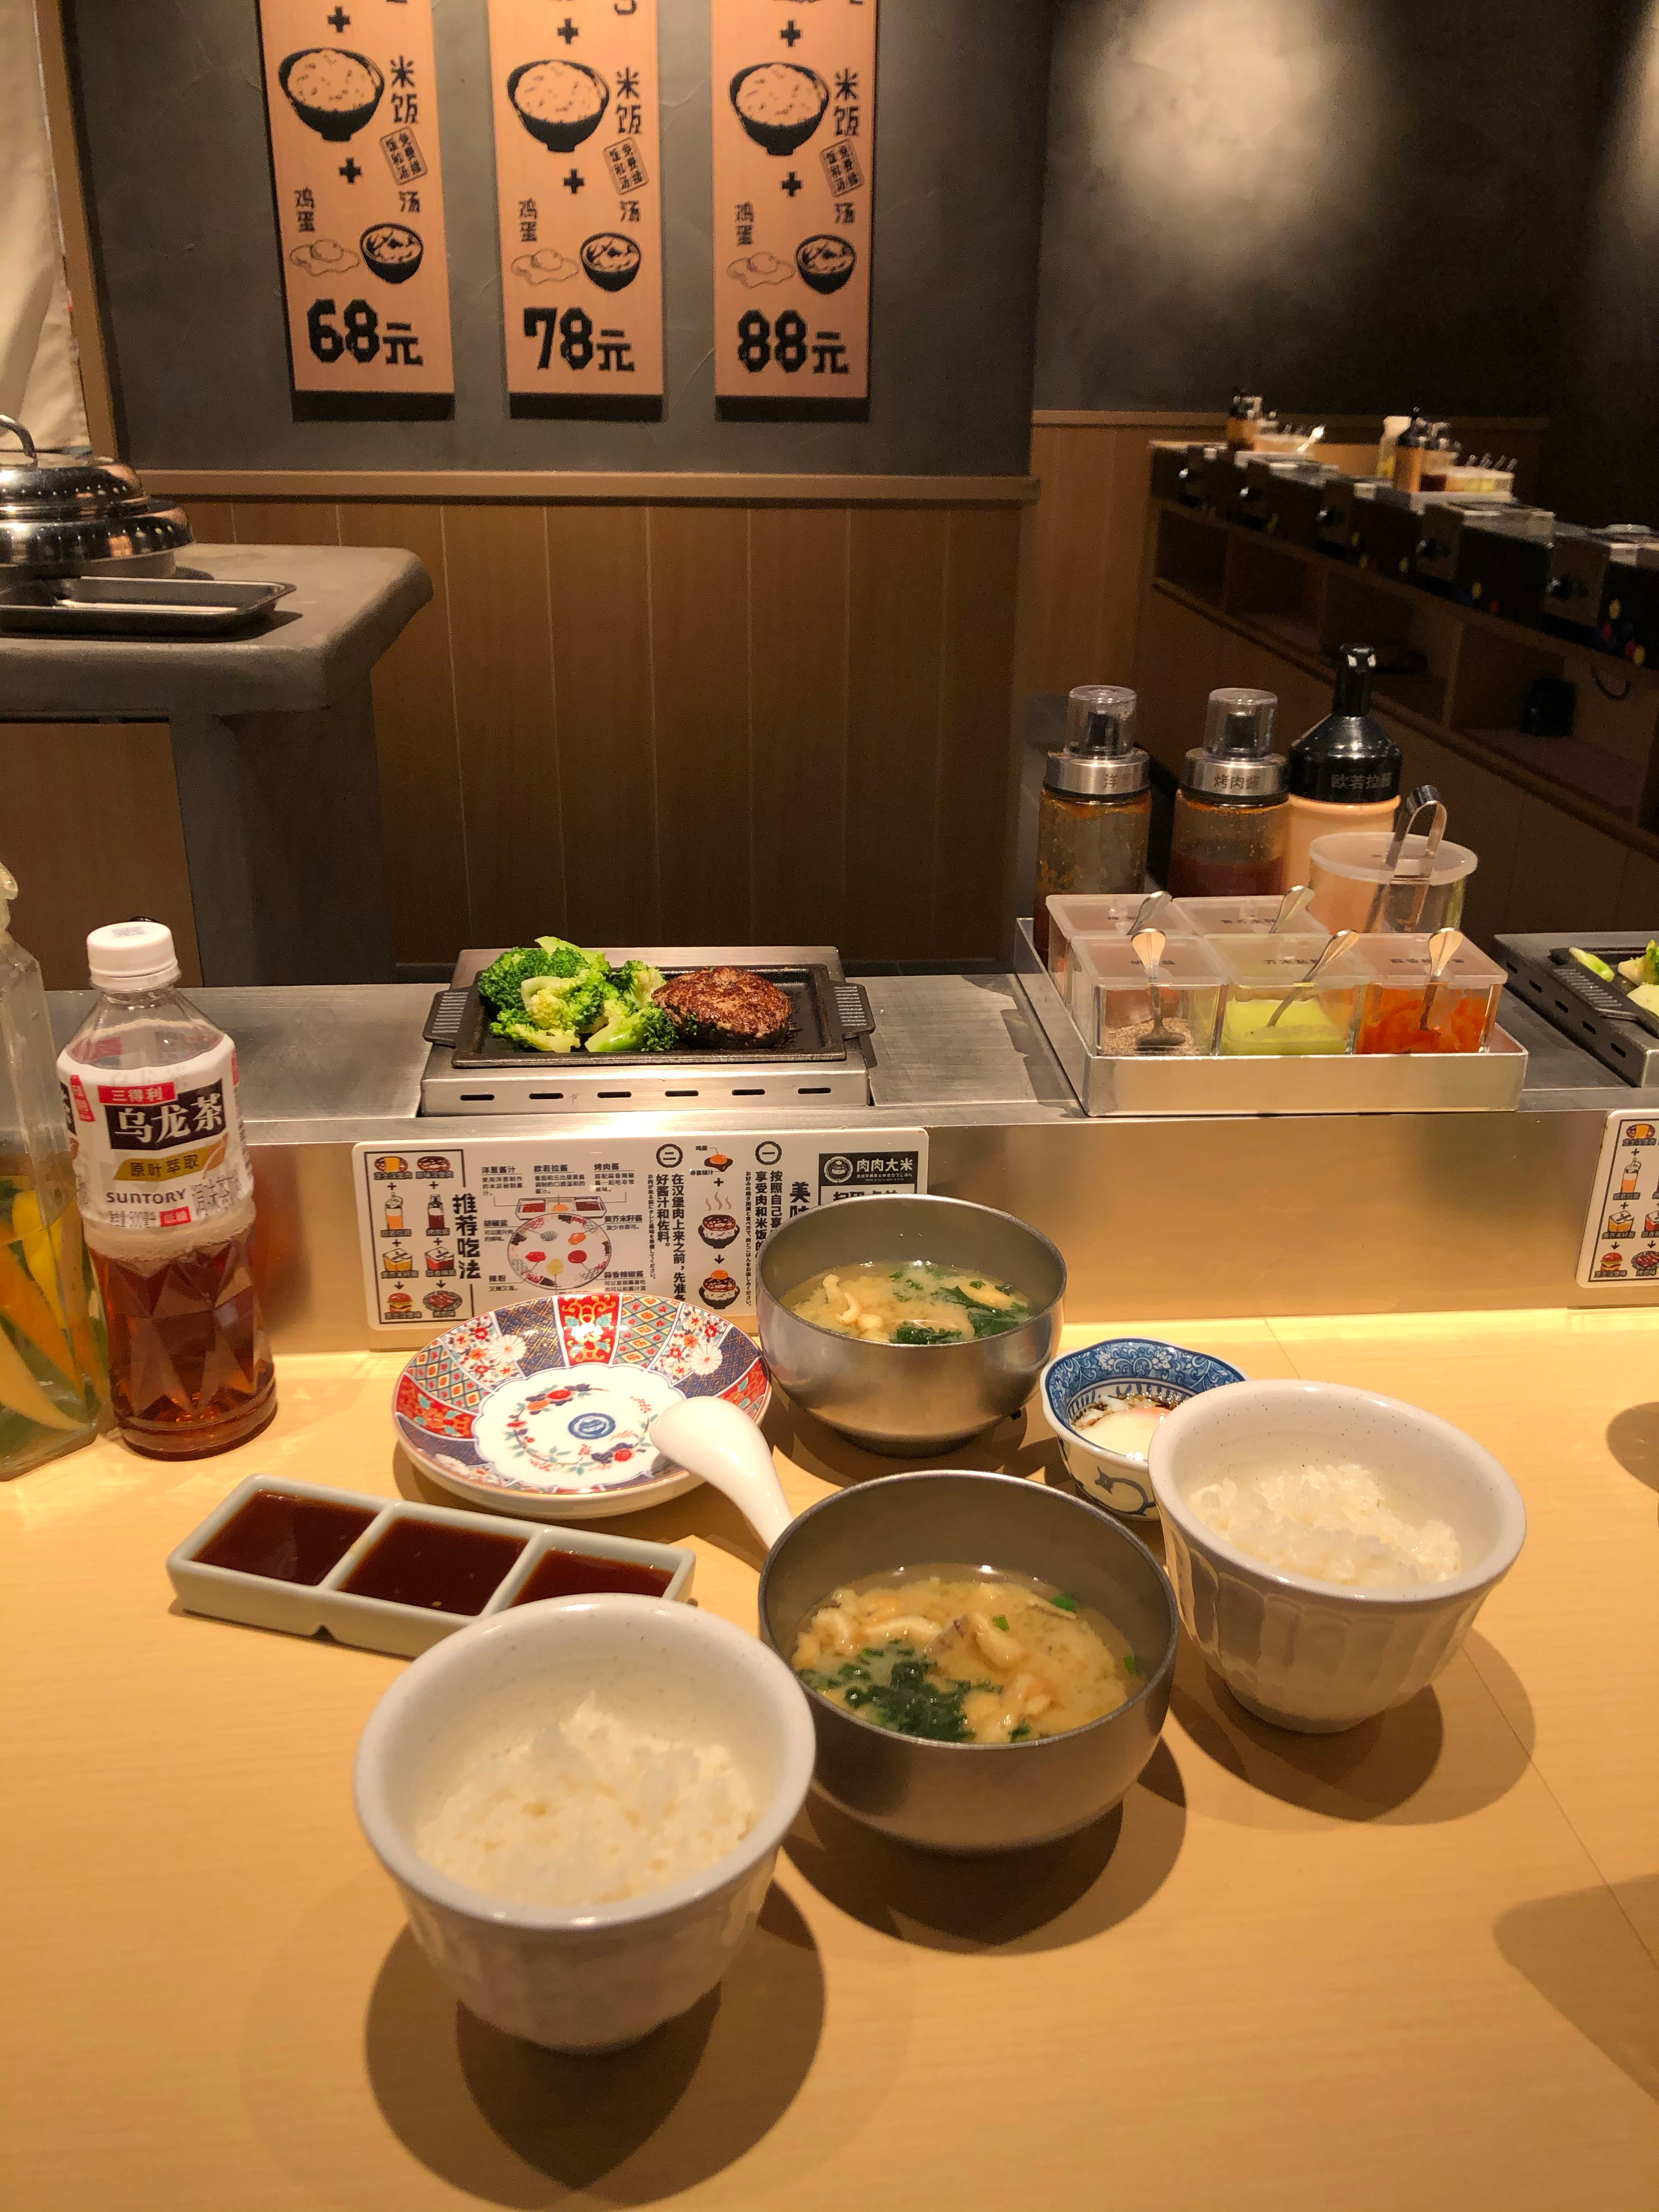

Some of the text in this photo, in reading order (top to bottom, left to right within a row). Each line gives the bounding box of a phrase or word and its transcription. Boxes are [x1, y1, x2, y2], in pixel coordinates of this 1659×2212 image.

[390, 55, 419, 124] 米饭
[615, 66, 642, 136] 米饭
[833, 67, 860, 137] 米饭
[294, 187, 315, 233] 鸡蛋
[399, 191, 420, 213] 汤
[518, 197, 539, 243] 鸡蛋
[619, 201, 640, 223] 汤
[734, 201, 755, 247] 鸡蛋
[834, 201, 855, 224] 汤
[307, 298, 424, 366] 68元
[523, 307, 635, 371] 78元
[737, 308, 849, 374] 88元
[1213, 773, 1260, 790] 烤肉酱
[111, 1086, 163, 1102] 三得利
[114, 1093, 222, 1144] 乌龙茶
[131, 1154, 199, 1177] 原叶萃取
[857, 1158, 913, 1172] 肉肉大米
[106, 1188, 187, 1205] SUNTORY
[755, 1171, 768, 1257] 享受肉和米饭的
[770, 1170, 783, 1233] 按照自己喜
[452, 1193, 482, 1279] 推荐吃法
